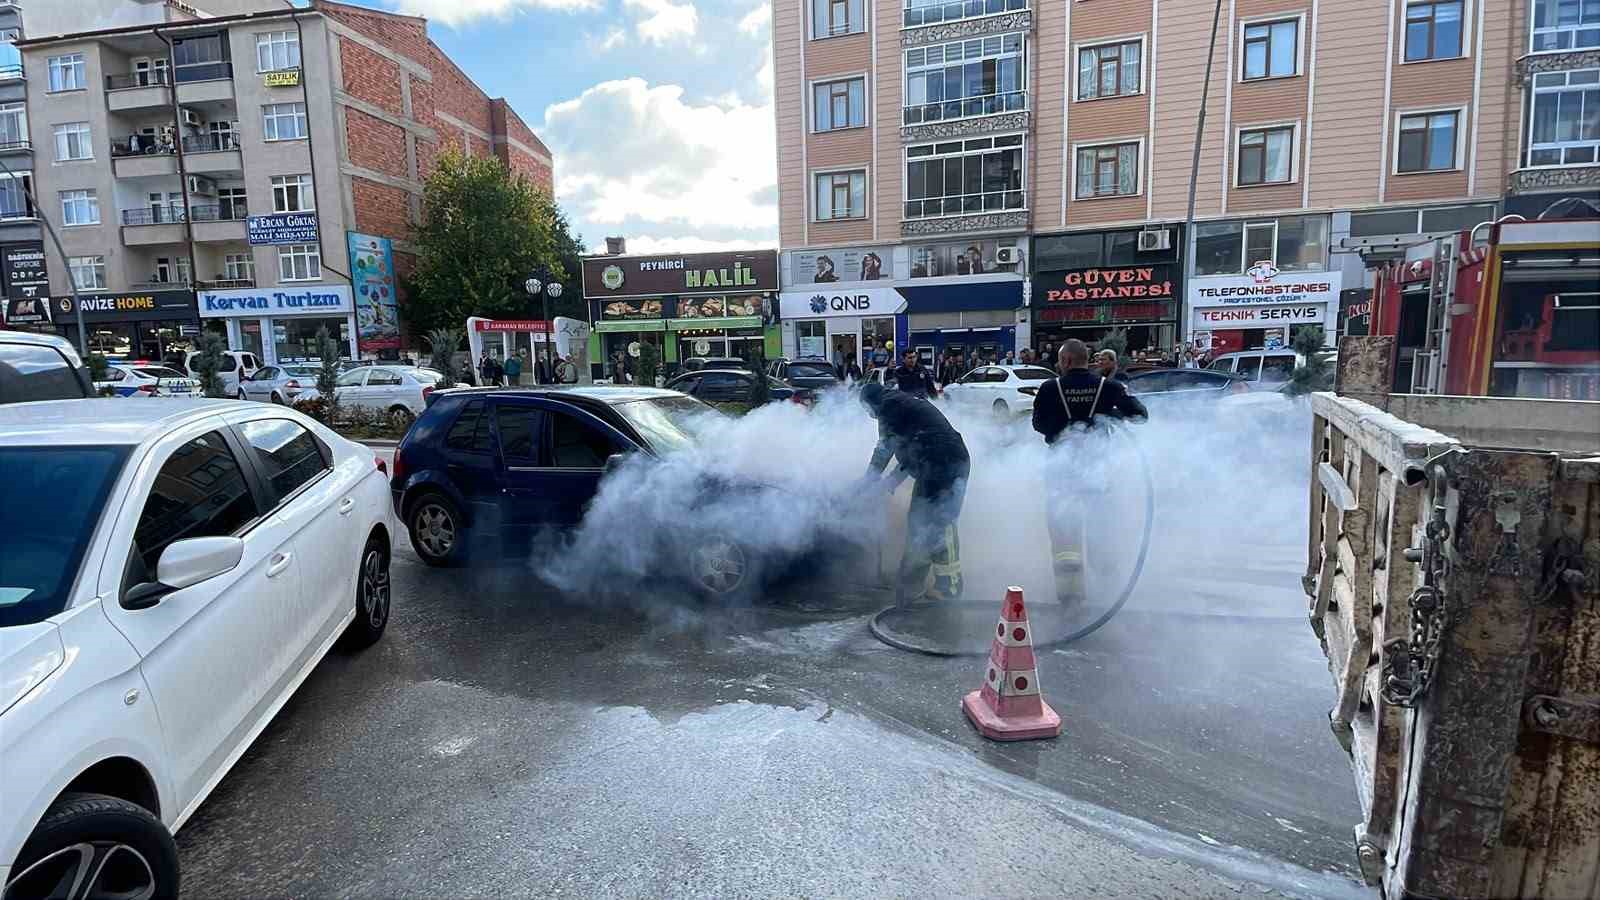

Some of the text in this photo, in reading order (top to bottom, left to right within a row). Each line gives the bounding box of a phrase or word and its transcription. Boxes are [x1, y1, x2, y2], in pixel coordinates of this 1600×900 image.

[266, 72, 298, 81] SATILIK
[260, 217, 285, 228] ERCAN
[640, 257, 684, 271] PEYNİRCİ
[685, 262, 757, 288] HALİL
[1064, 267, 1154, 286] GÜVEN
[1047, 281, 1172, 302] PASTANESİ
[80, 296, 154, 312] AVİZE HOME
[204, 294, 269, 311] Kervan
[830, 295, 870, 312] QNB
[1202, 307, 1317, 321] TEKNİK SERVİS
